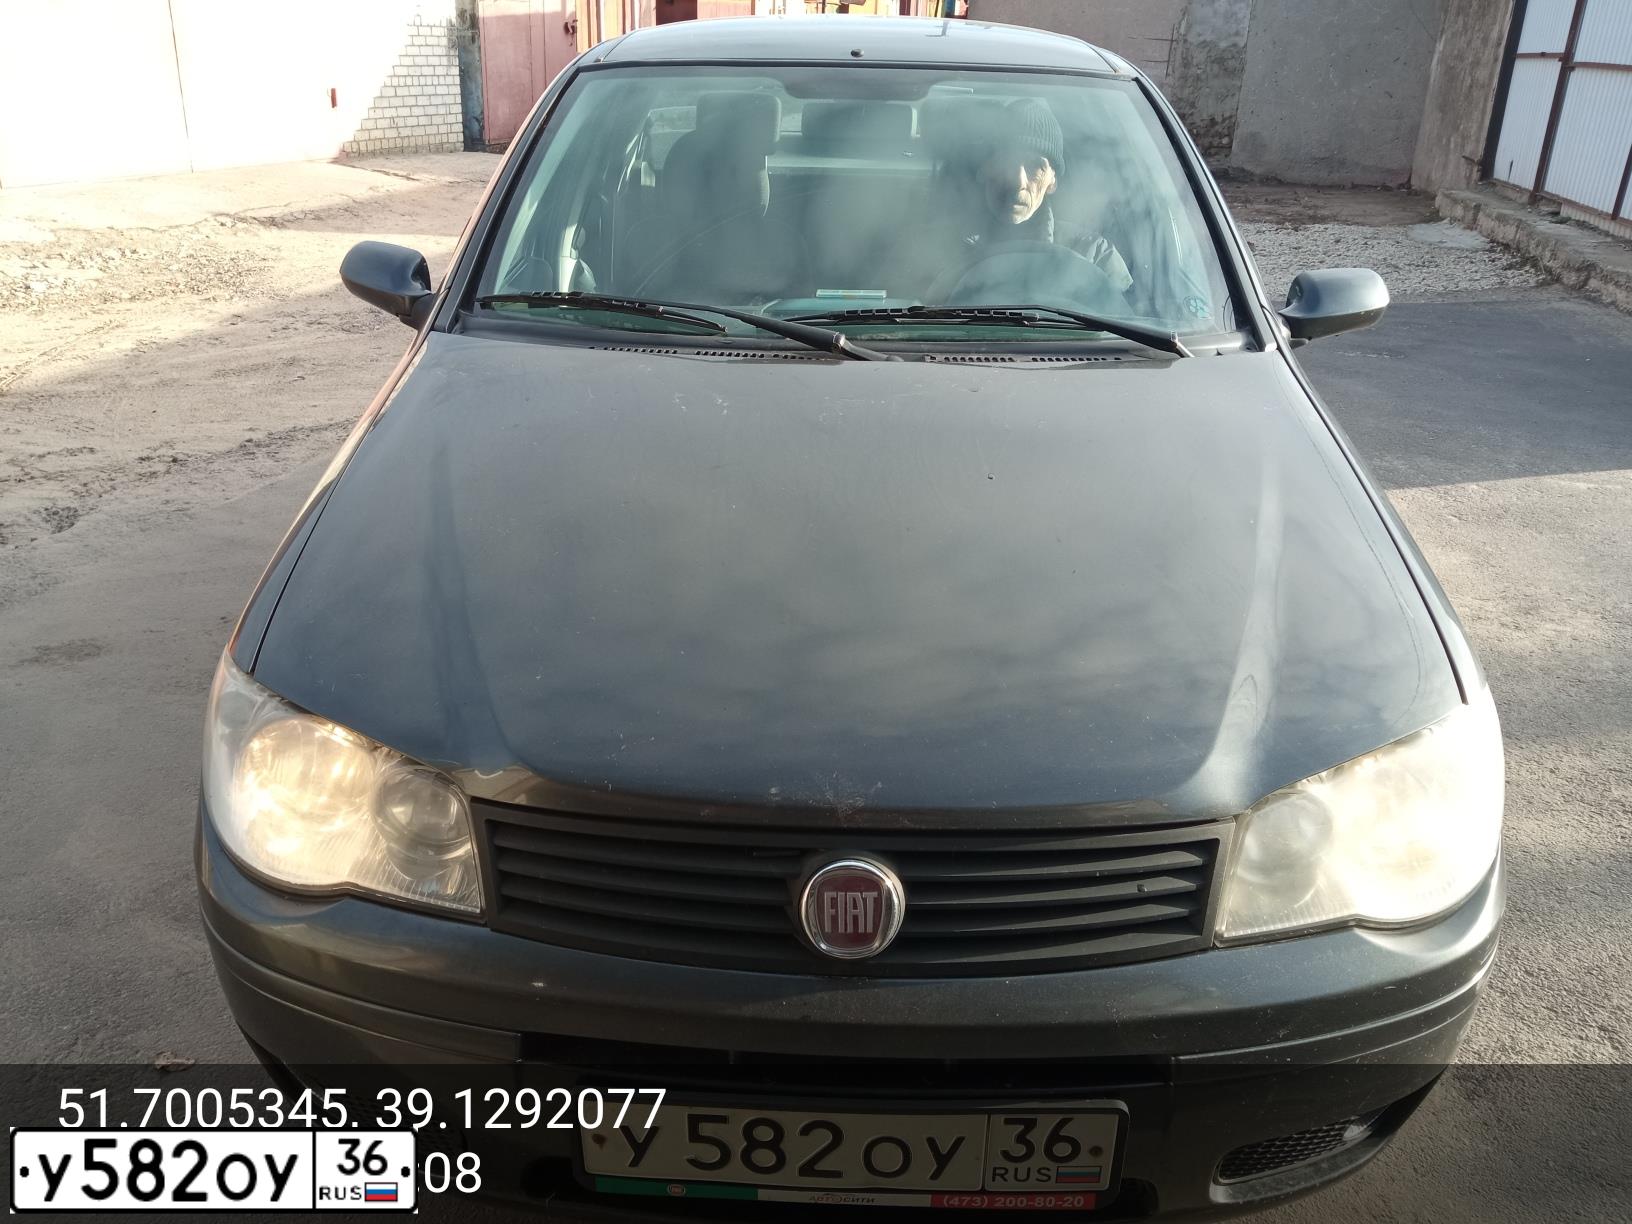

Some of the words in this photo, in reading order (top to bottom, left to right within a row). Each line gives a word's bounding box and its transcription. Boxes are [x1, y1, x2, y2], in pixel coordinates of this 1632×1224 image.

[824, 891, 879, 934] FIAT
[1000, 1117, 1083, 1164] 36
[991, 1166, 1053, 1184] RUS
[943, 1194, 988, 1208] (473)
[993, 1195, 1085, 1208] 200-80-20
